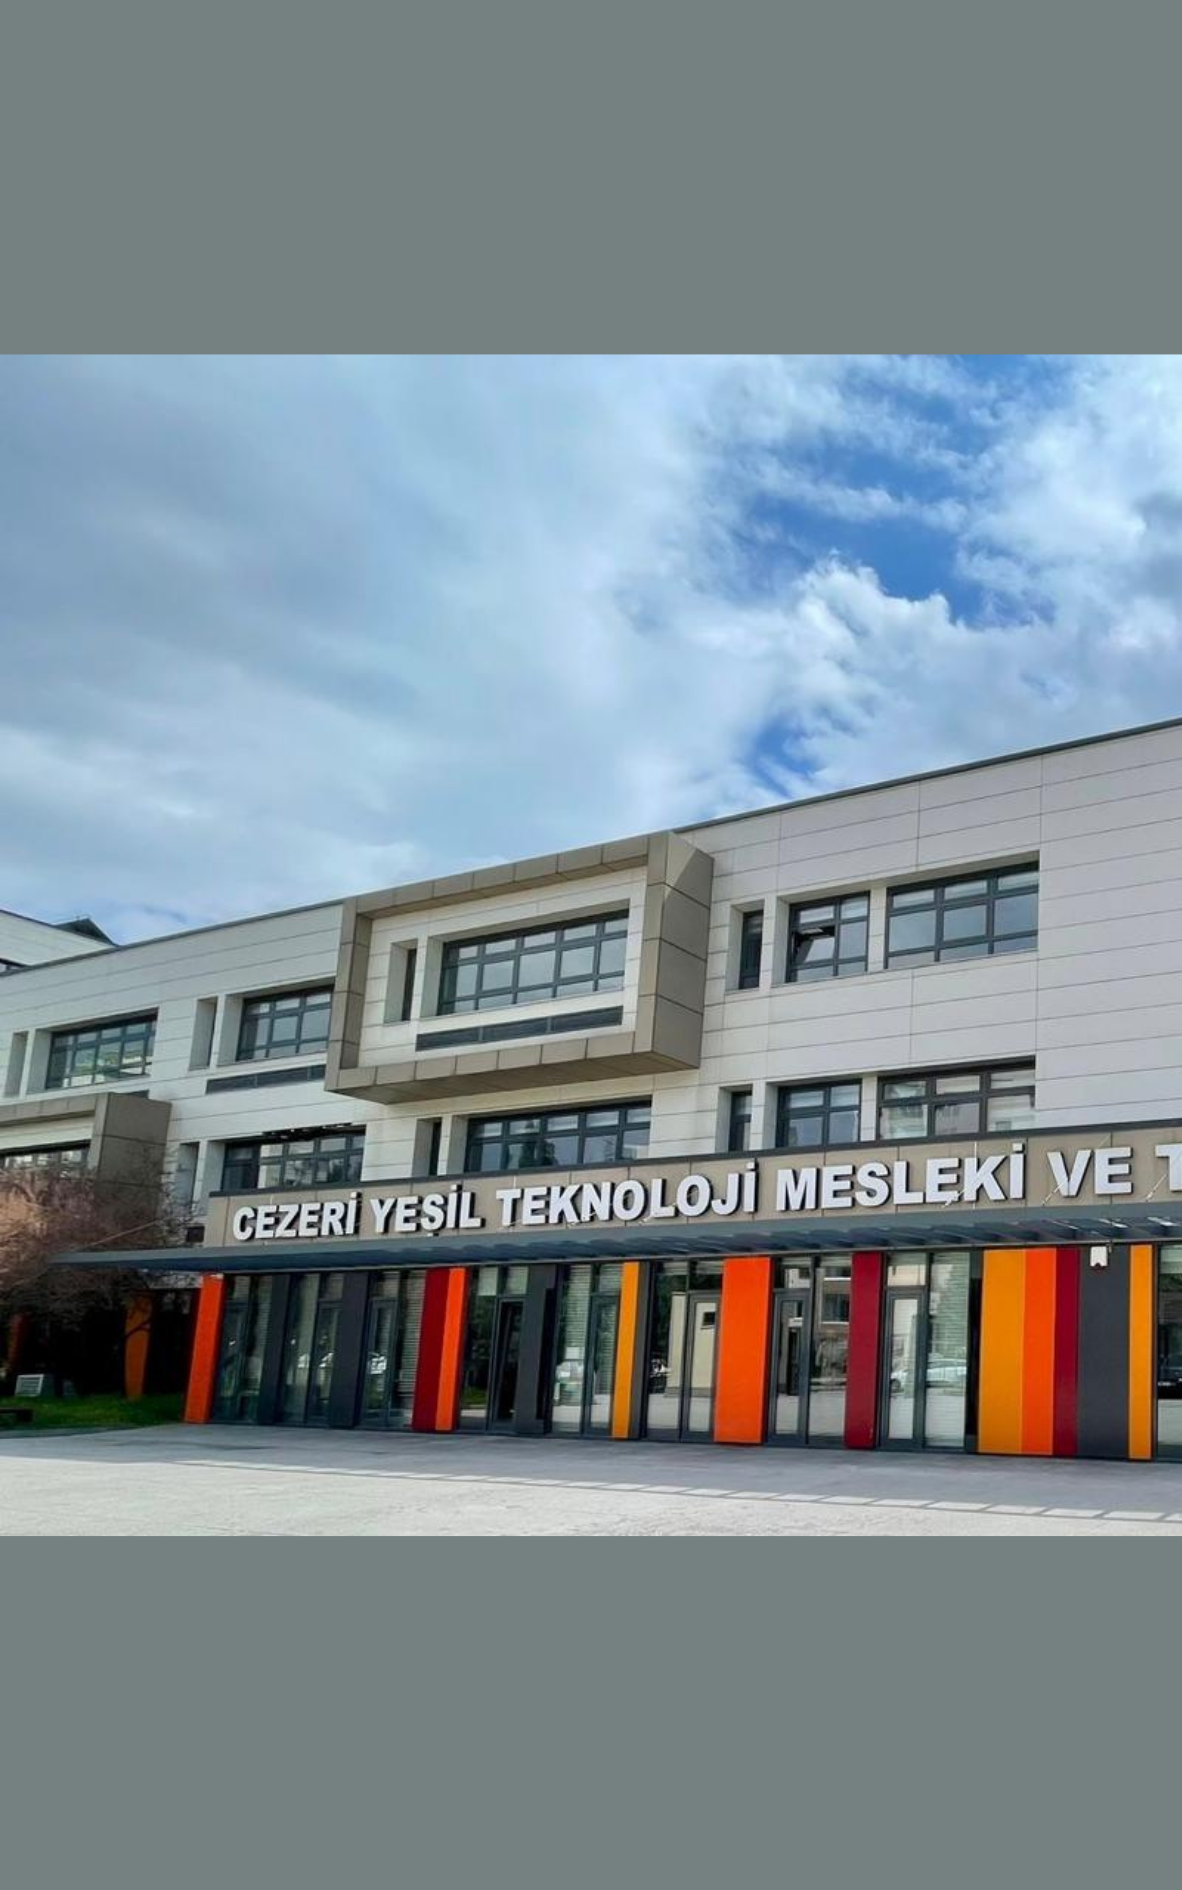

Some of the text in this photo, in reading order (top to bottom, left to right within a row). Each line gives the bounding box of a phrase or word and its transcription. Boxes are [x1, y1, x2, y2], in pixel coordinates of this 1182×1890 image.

[232, 1192, 360, 1241] CEZERİ
[370, 1184, 483, 1237] YEŞİL
[496, 1163, 757, 1227] TEKNOLOJİ
[775, 1143, 1025, 1209] MESLEKİ
[1047, 1147, 1132, 1196] VE
